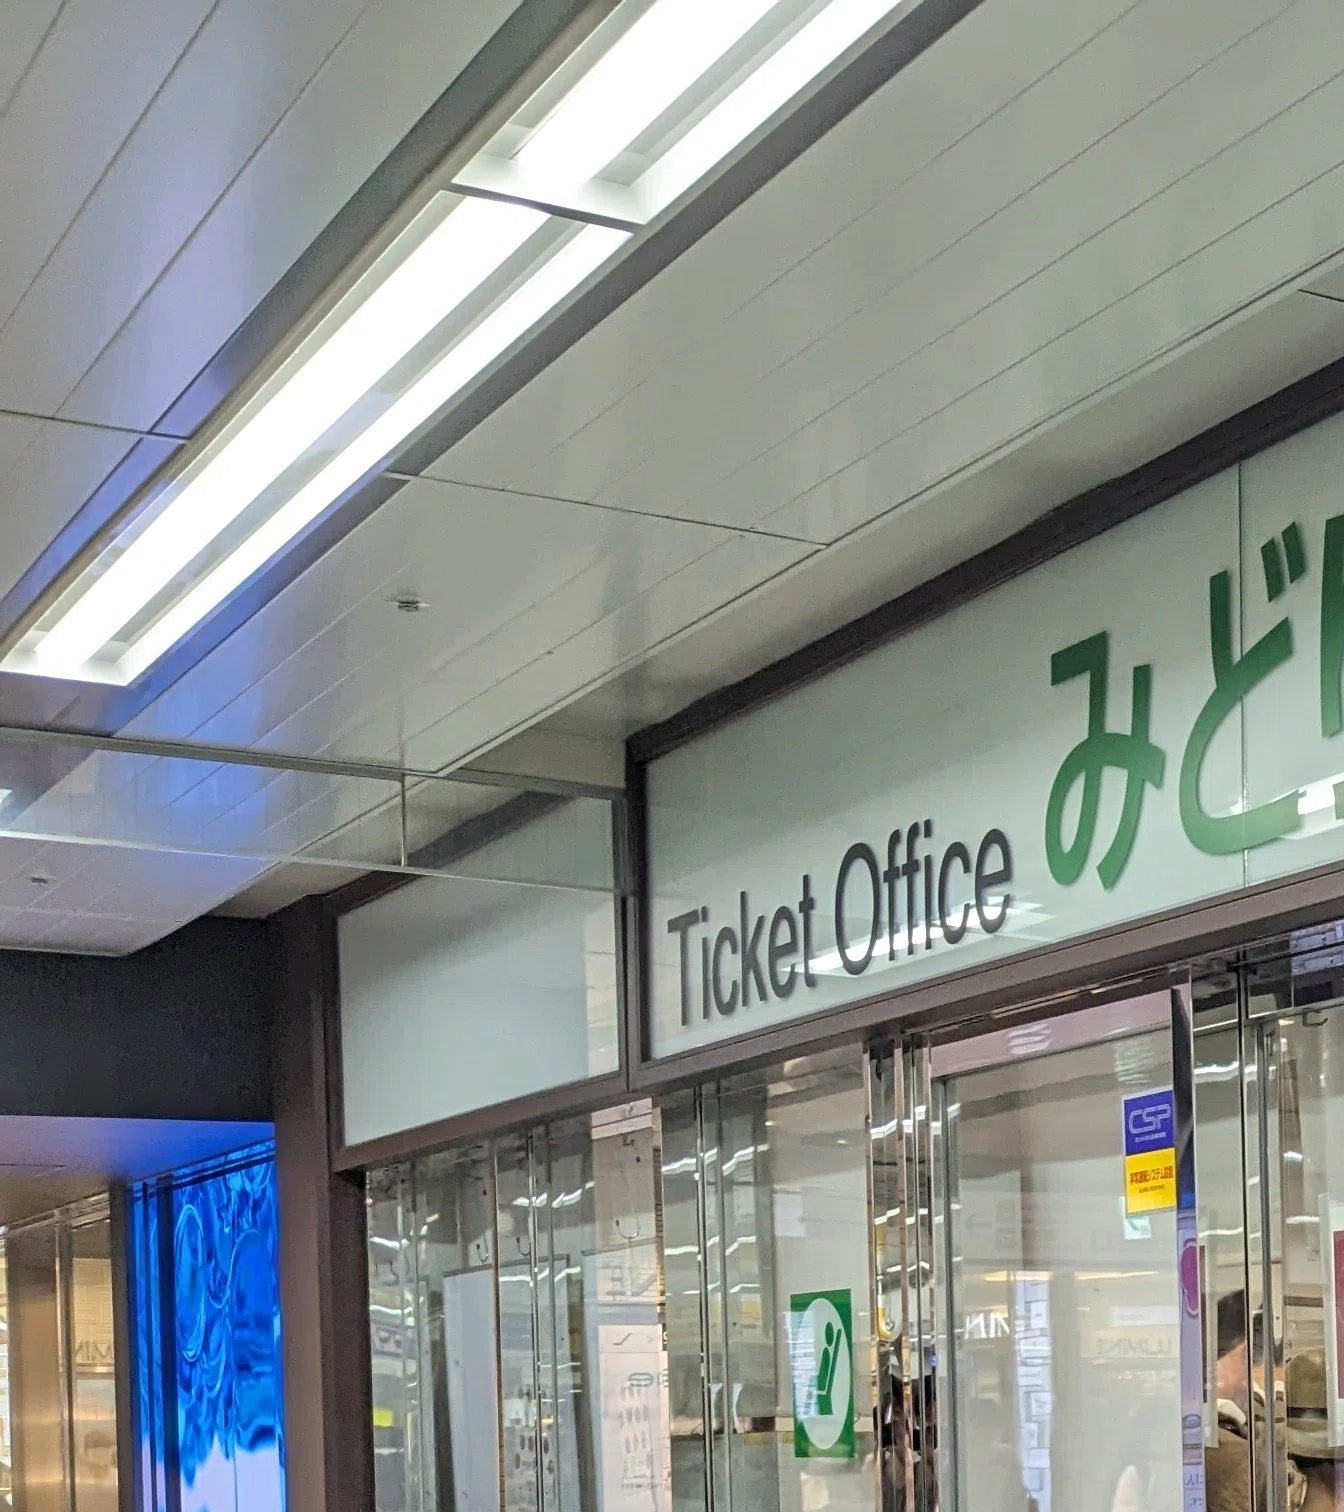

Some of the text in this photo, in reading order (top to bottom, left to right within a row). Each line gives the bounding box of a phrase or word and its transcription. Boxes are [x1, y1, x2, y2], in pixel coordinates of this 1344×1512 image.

[667, 874, 816, 1026] Ticket
[835, 819, 1013, 976] Office
[1129, 1103, 1171, 1134] CSP
